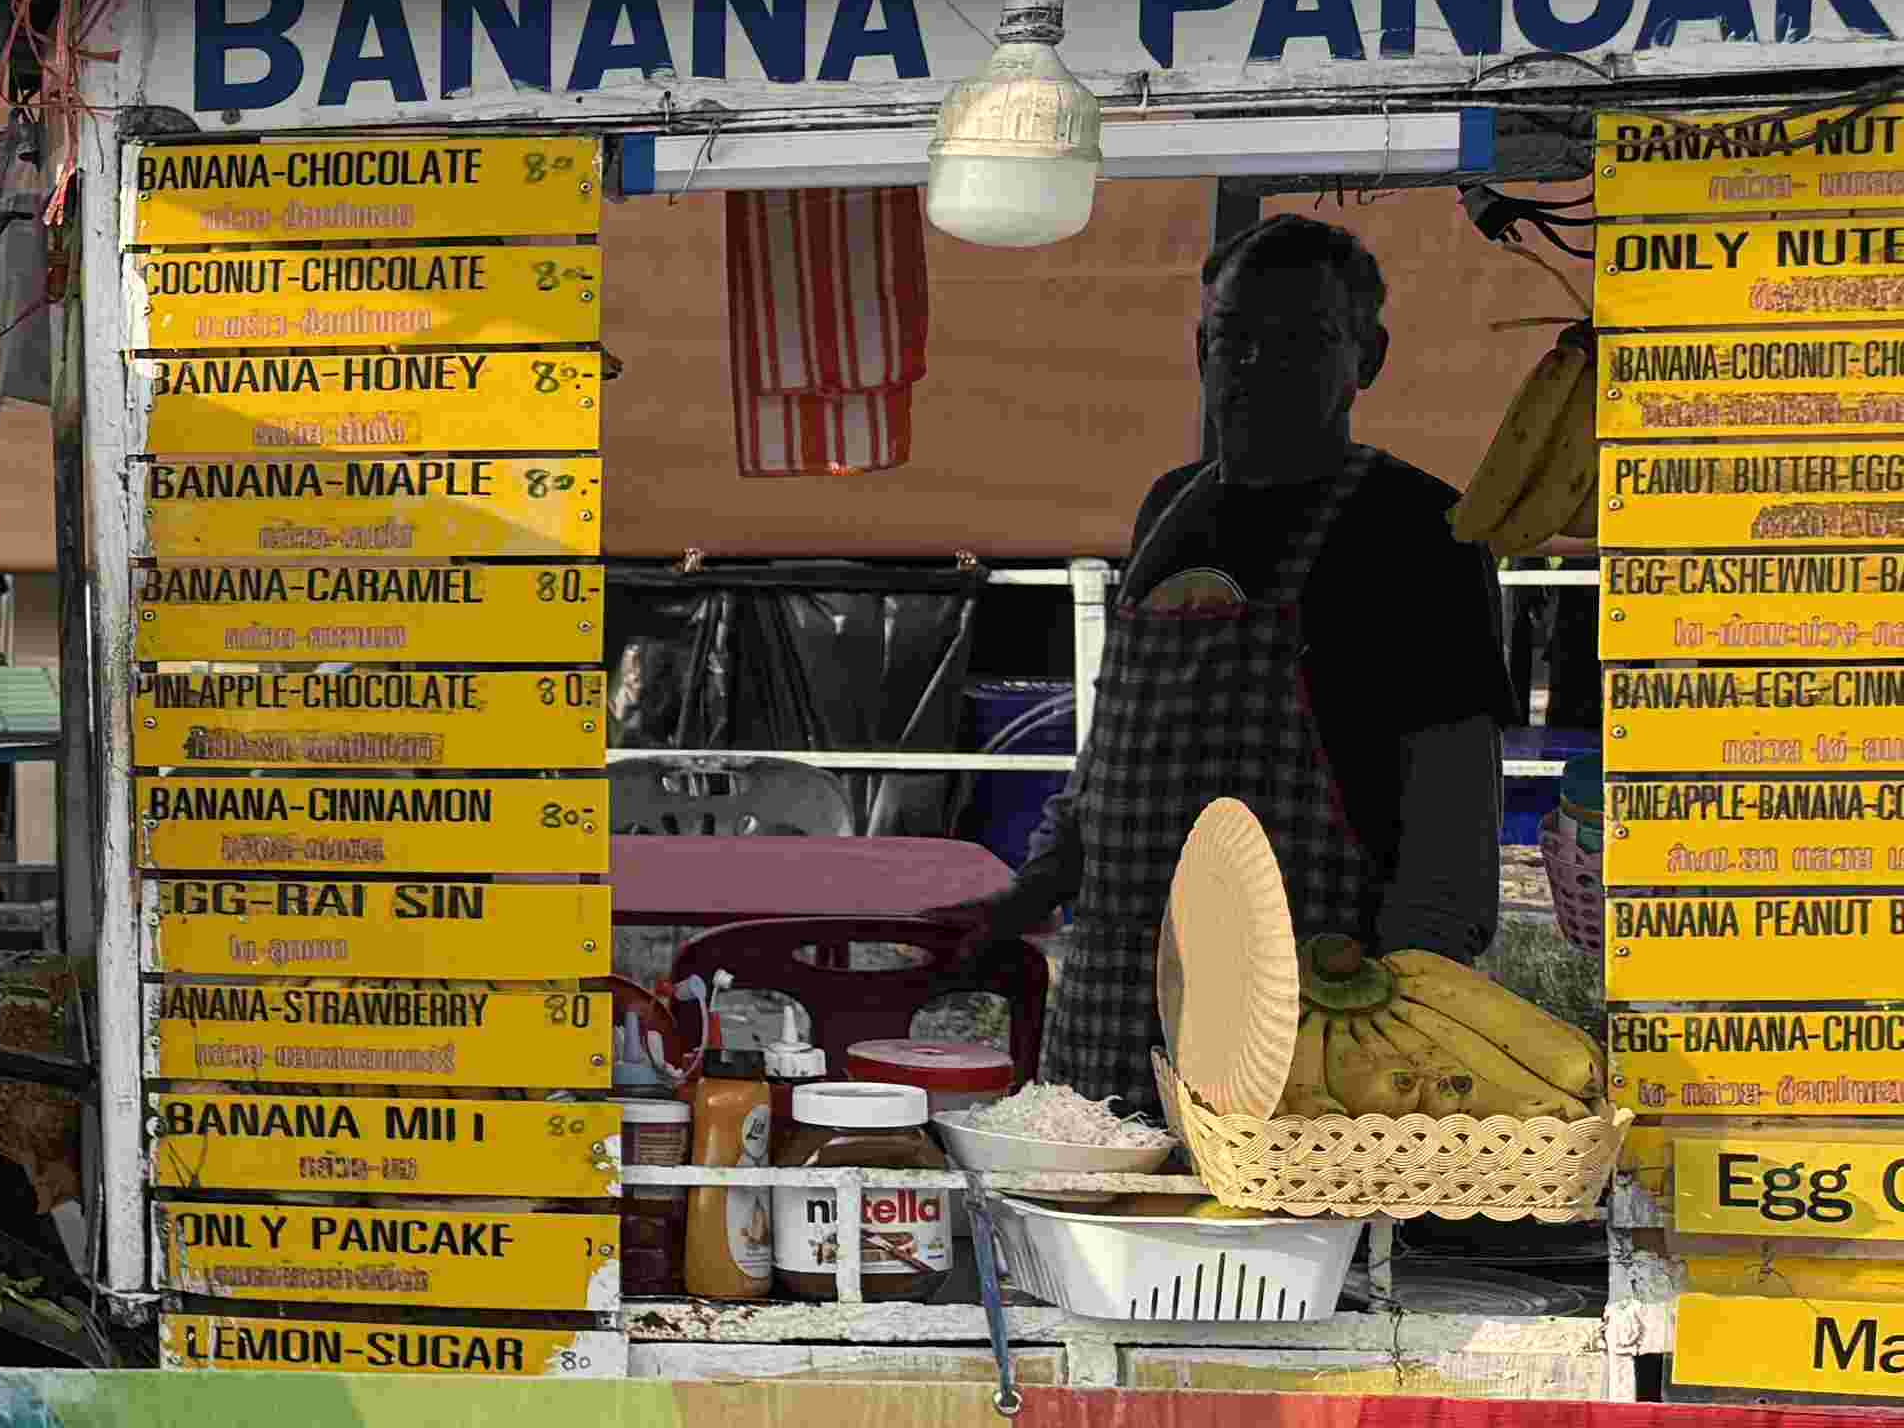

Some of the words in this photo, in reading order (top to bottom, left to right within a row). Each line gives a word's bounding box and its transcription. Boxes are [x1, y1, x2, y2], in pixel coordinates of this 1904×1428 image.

[1616, 122, 1792, 163] BANANA
[137, 148, 482, 190] BANANA-CHOCOLATE
[1615, 231, 1748, 272] ONLY
[1775, 227, 1904, 270] NUTE
[142, 254, 485, 296] COCONUT-CHOCOLATE
[151, 355, 486, 396] BANANA-HONEY
[150, 460, 492, 499] BANANA-MAPLE
[1615, 458, 1719, 494] PEANUT
[141, 567, 483, 605] BANANA-CARAMEL
[150, 786, 492, 822] BANANA-CINNAMON
[1614, 900, 1740, 939] BANANA
[1754, 898, 1874, 937] PEANUT
[165, 1101, 361, 1141] BANANA
[805, 1187, 942, 1225] ntella
[1717, 1151, 1854, 1224] Egg
[175, 1211, 289, 1250] ONLY
[310, 1217, 515, 1258] PANCAKE
[185, 1324, 524, 1371] LEMON-SUGAR
[559, 1349, 591, 1371] 80
